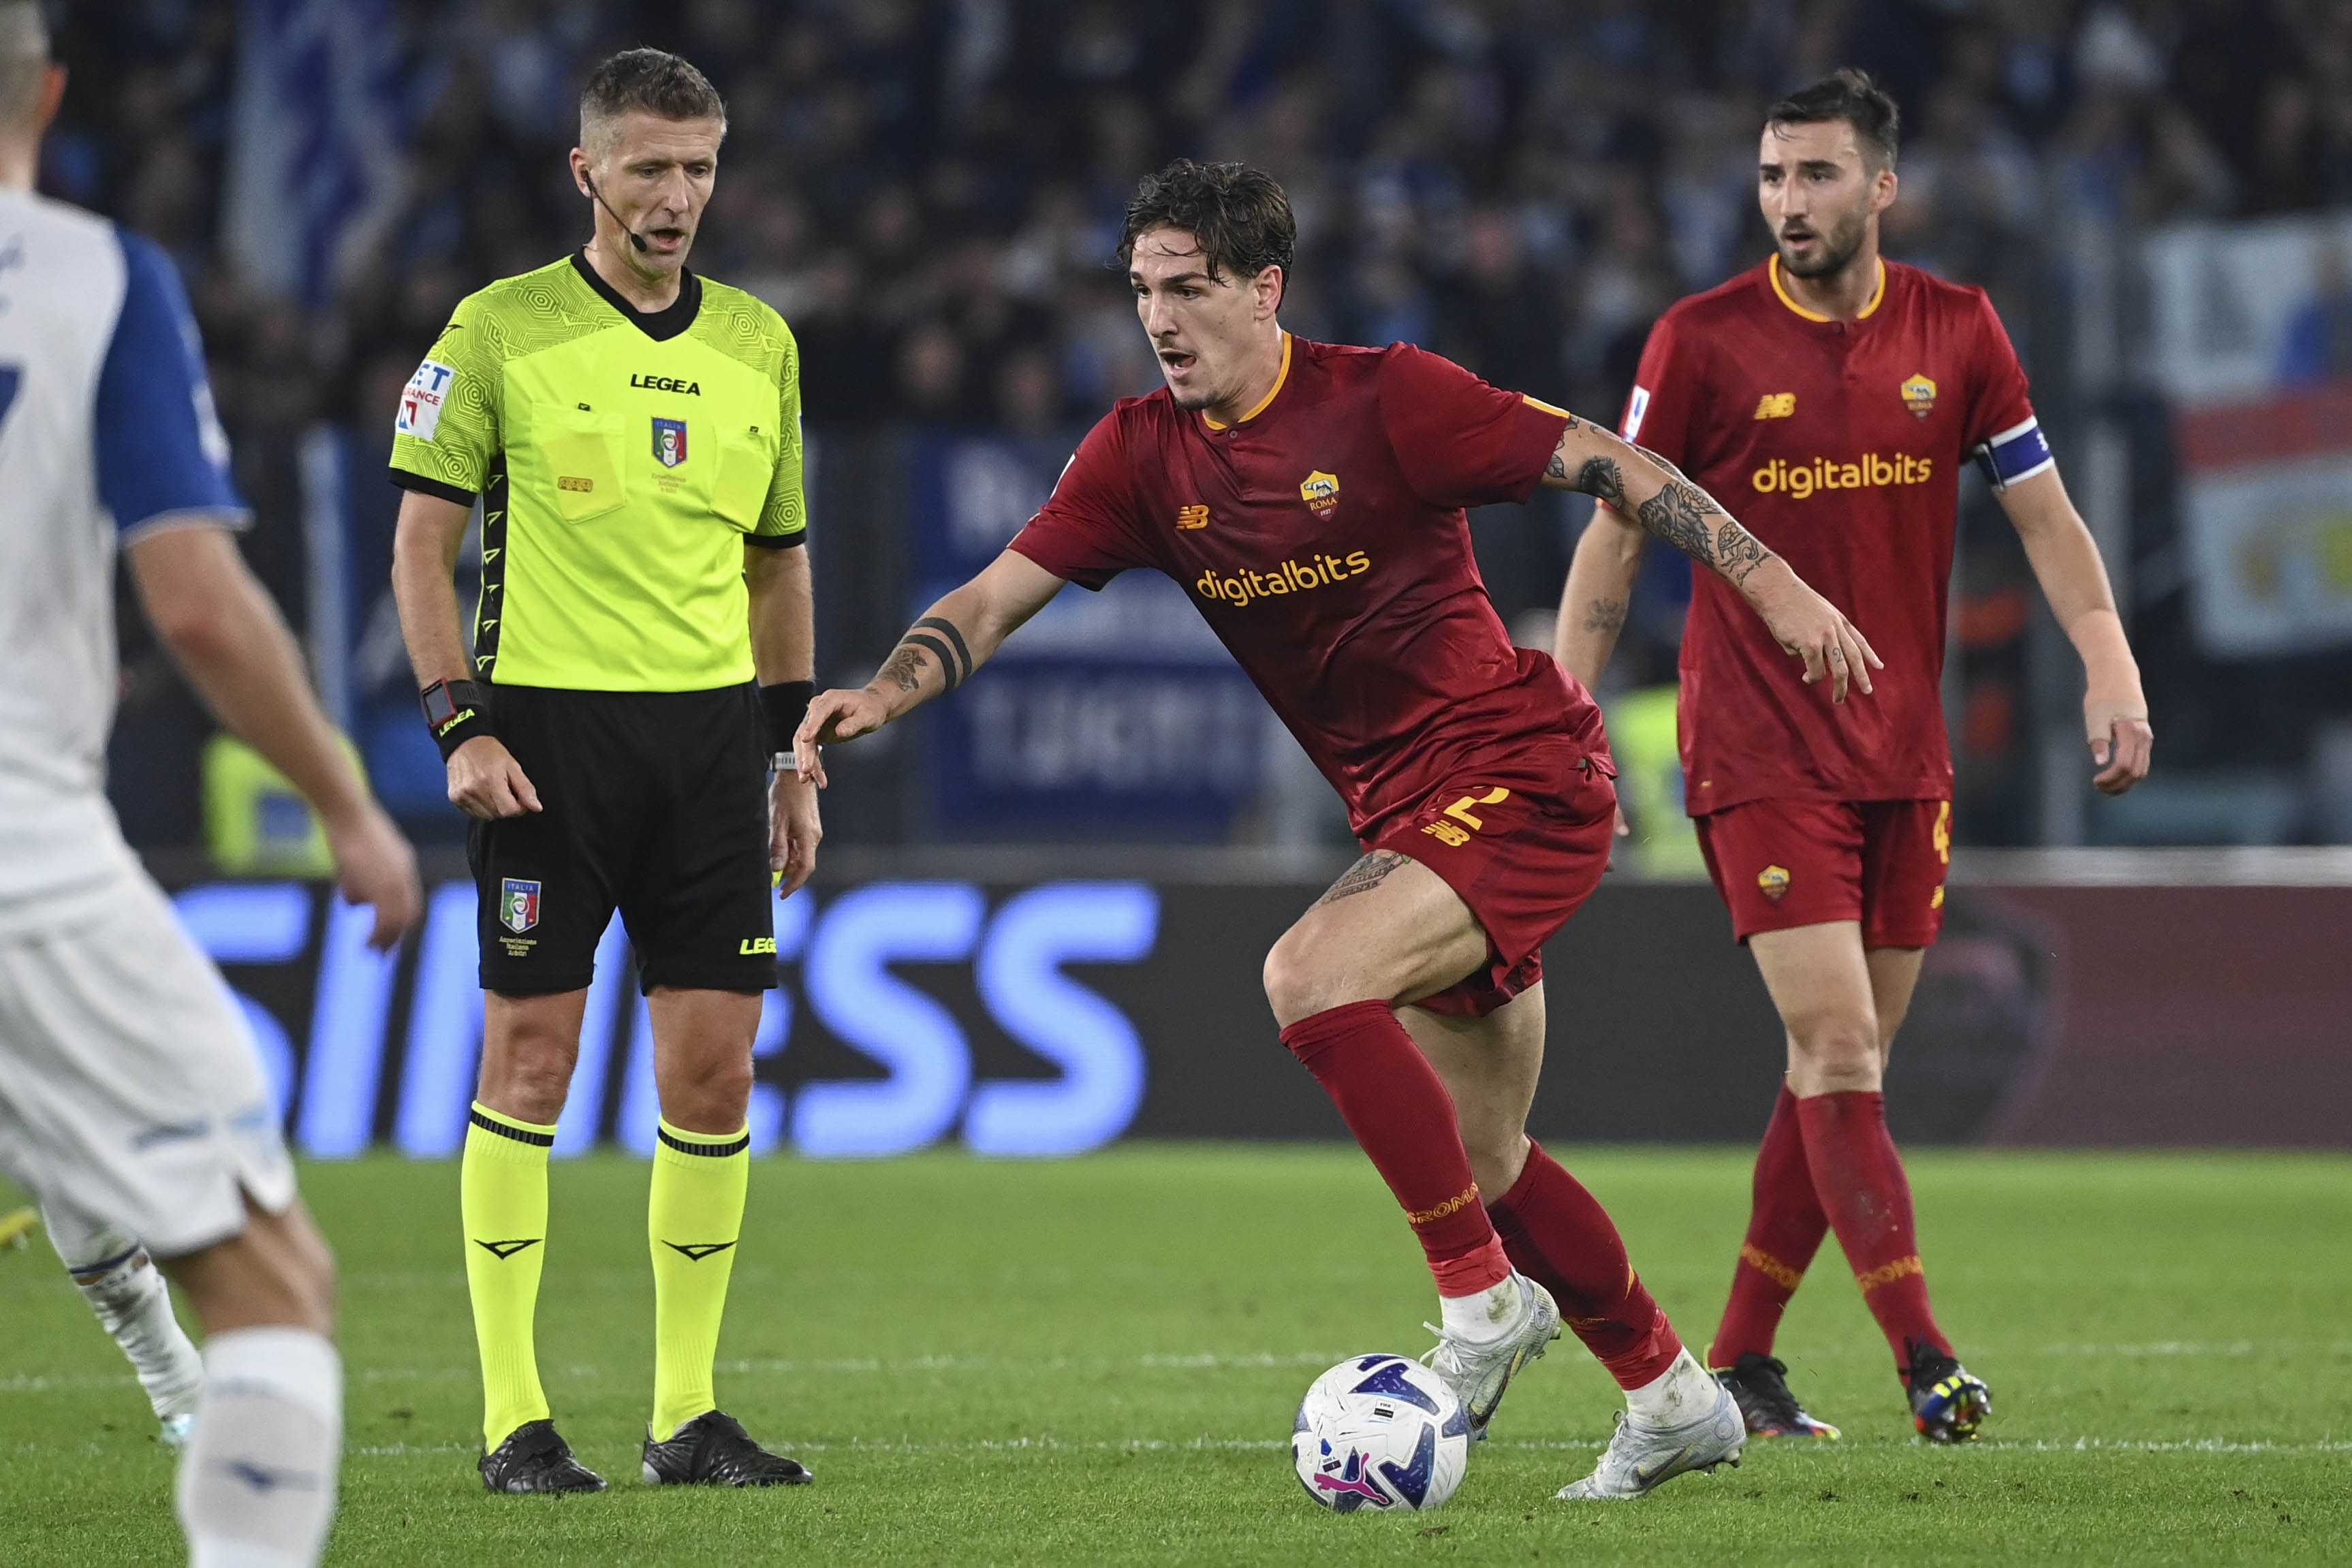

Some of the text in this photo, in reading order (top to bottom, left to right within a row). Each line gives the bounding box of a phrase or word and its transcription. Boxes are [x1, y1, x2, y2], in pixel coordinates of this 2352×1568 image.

[630, 373, 702, 396] LEGEA
[1752, 452, 1933, 499] digitalbits
[1309, 497, 1338, 512] ROMA
[1196, 550, 1371, 607] digitalbits
[438, 708, 475, 738] LEGEA
[507, 883, 534, 892] ITALIA
[738, 937, 777, 955] LEG
